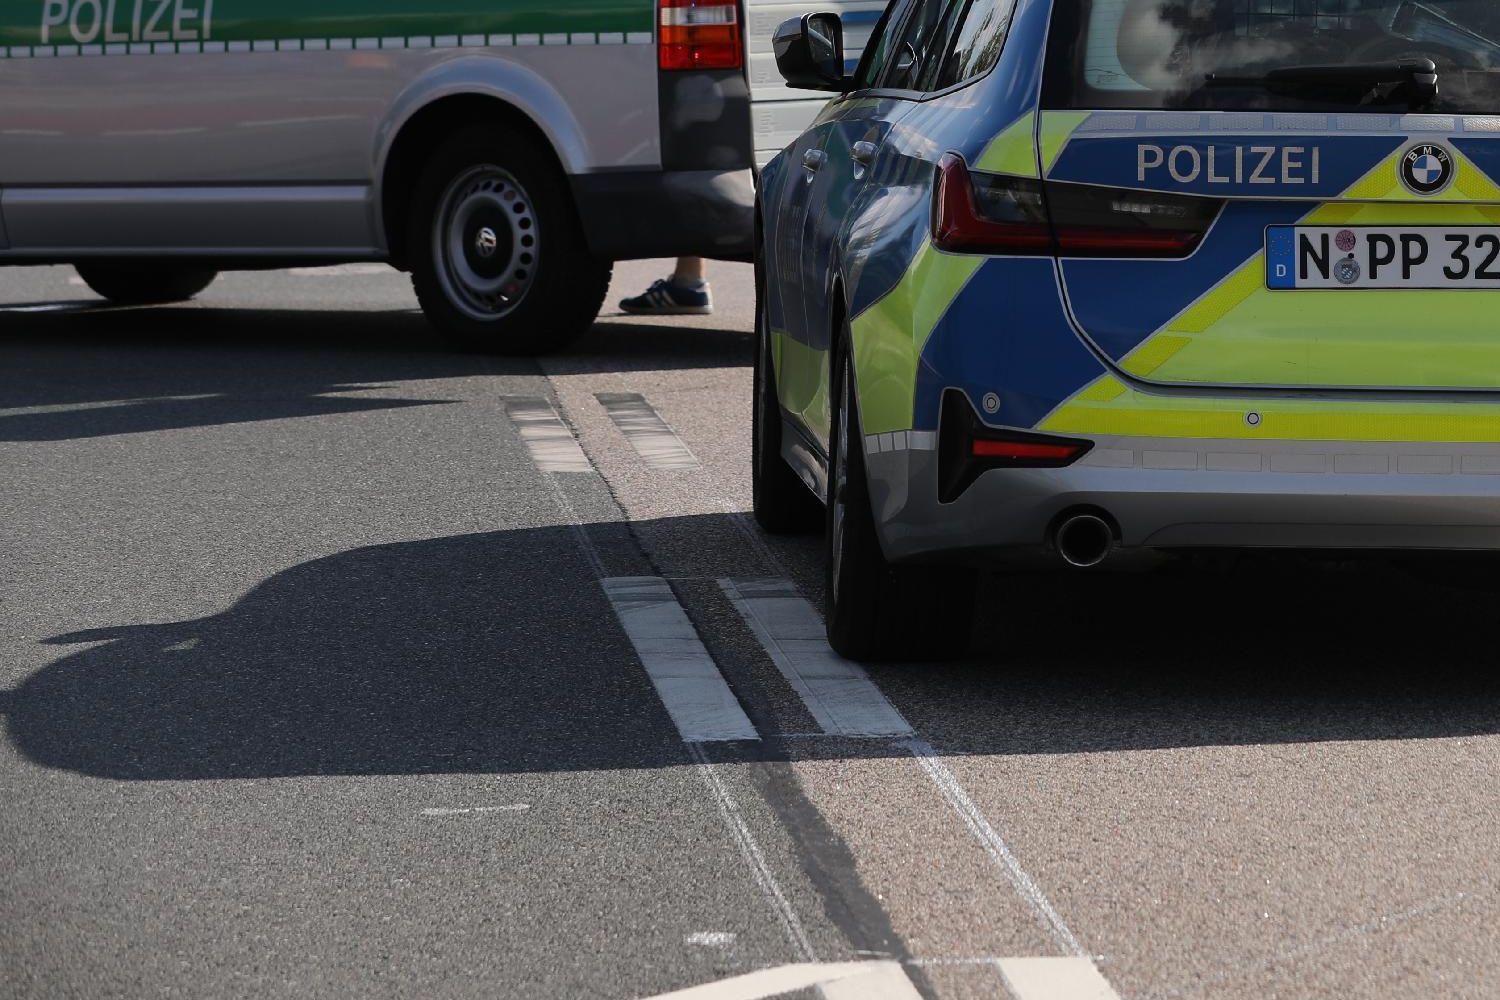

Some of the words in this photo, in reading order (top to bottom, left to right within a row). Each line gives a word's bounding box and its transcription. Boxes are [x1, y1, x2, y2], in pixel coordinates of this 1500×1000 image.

[1137, 144, 1320, 184] POLIZEI
[1275, 264, 1288, 278] D
[1299, 233, 1331, 280] N
[1366, 233, 1429, 280] PP
